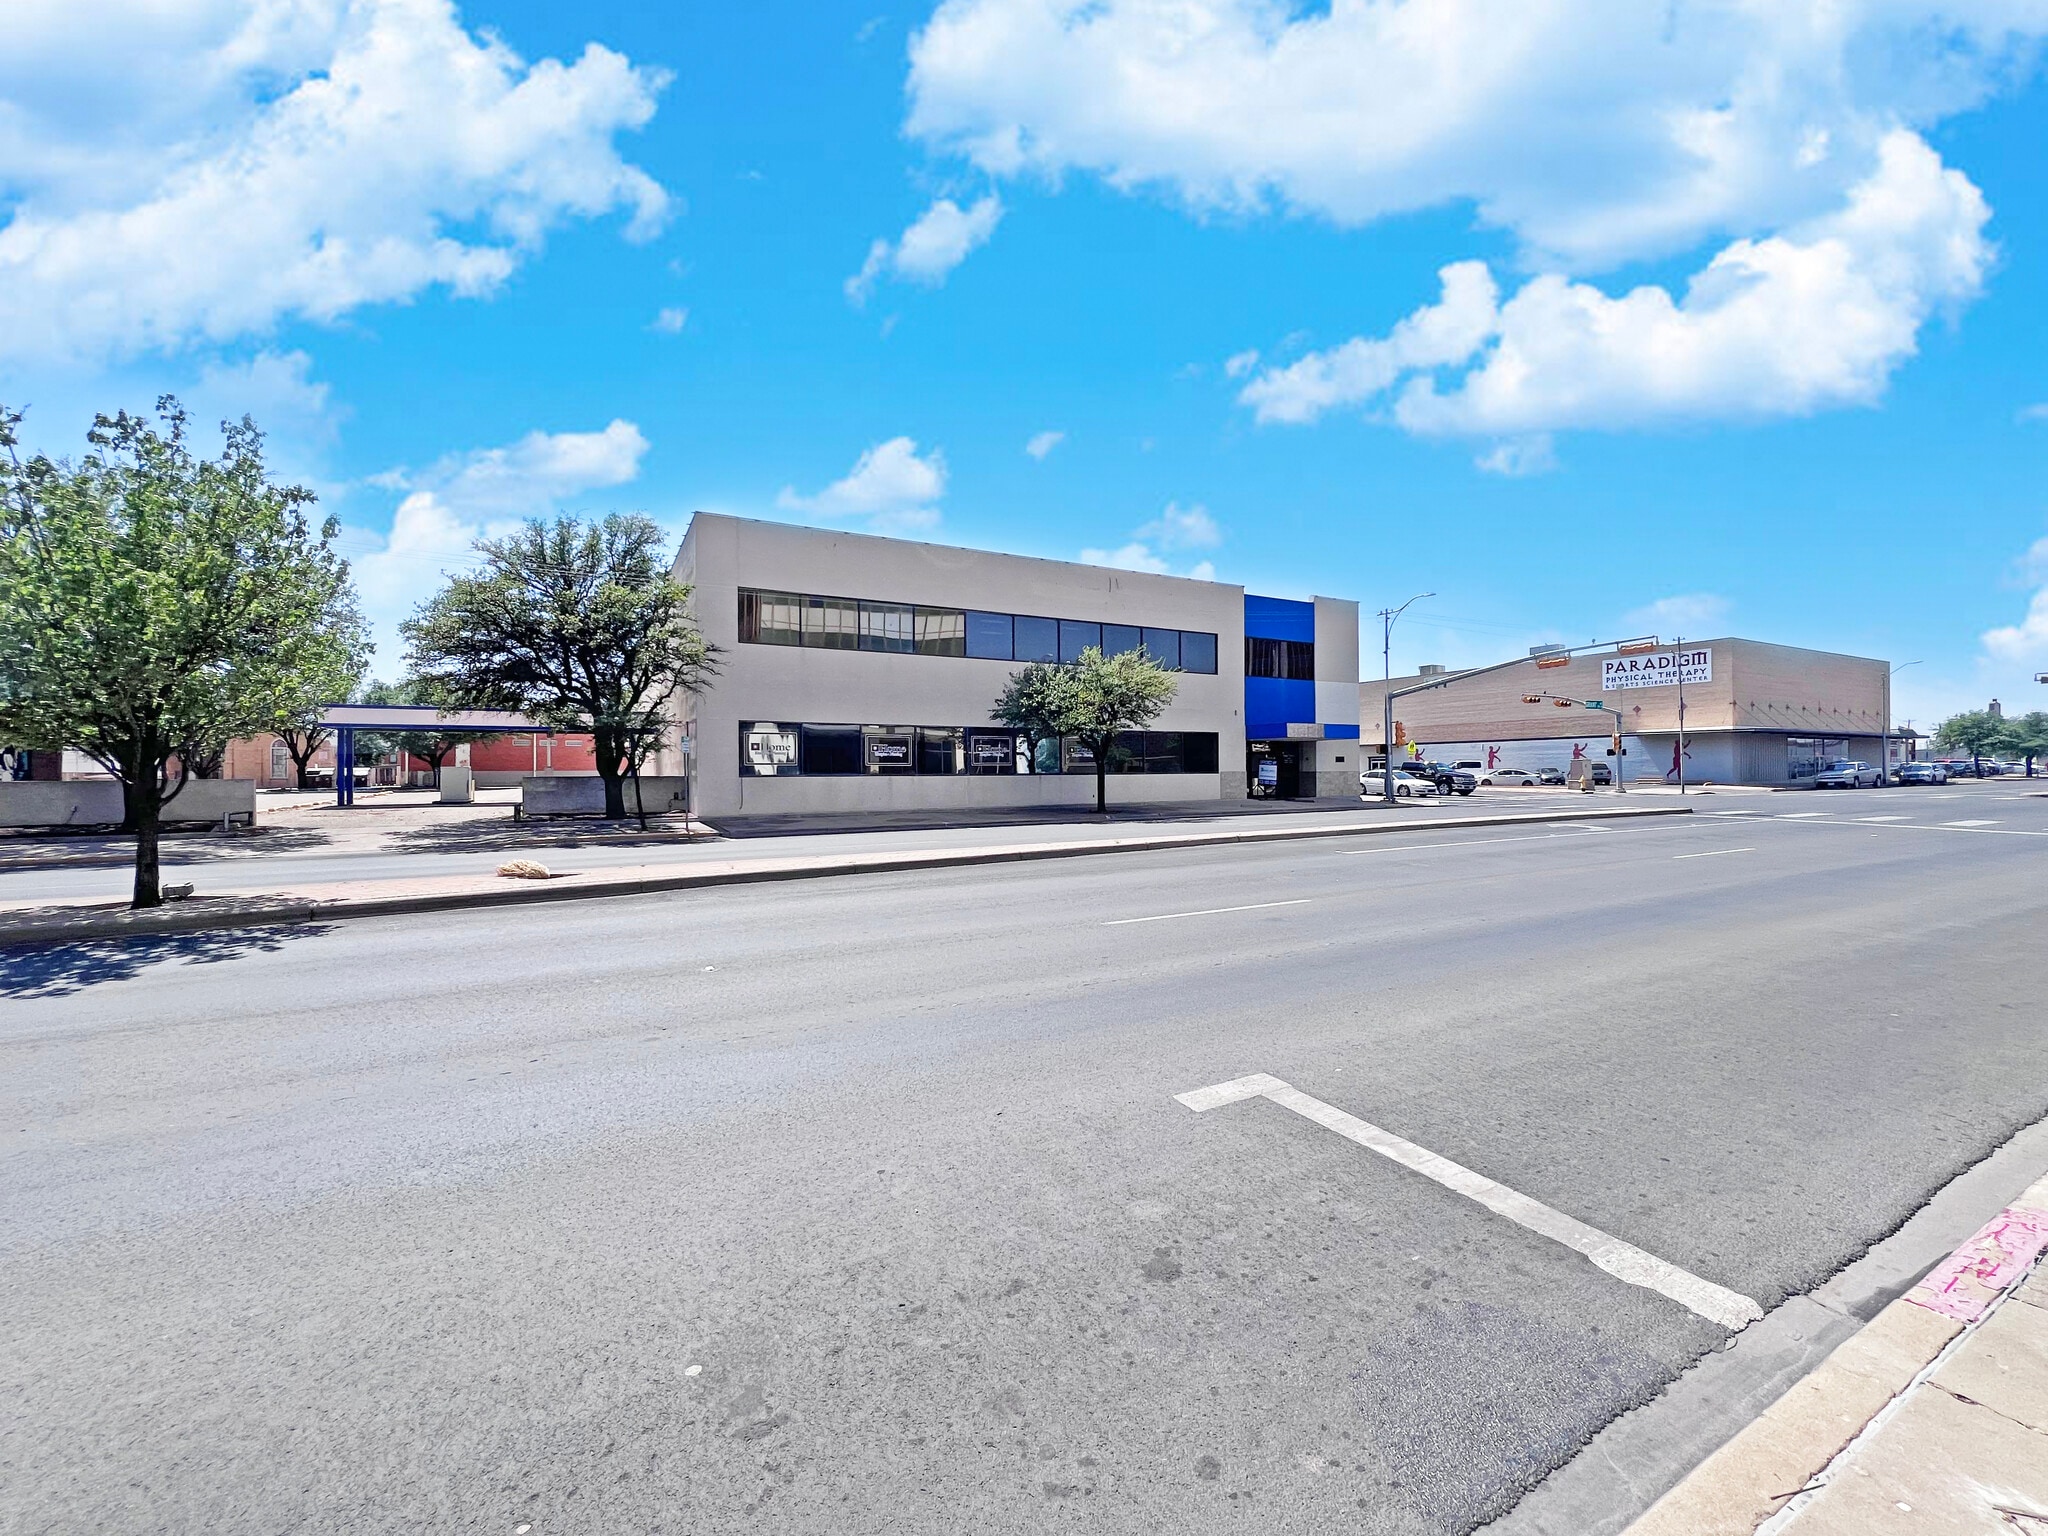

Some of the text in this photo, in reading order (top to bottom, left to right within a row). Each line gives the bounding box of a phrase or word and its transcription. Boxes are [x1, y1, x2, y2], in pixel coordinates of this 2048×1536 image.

[1605, 652, 1708, 674] PARADIGM
[1606, 667, 1707, 683] PHYSICAL THERAPY
[1612, 681, 1639, 689] SRTS
